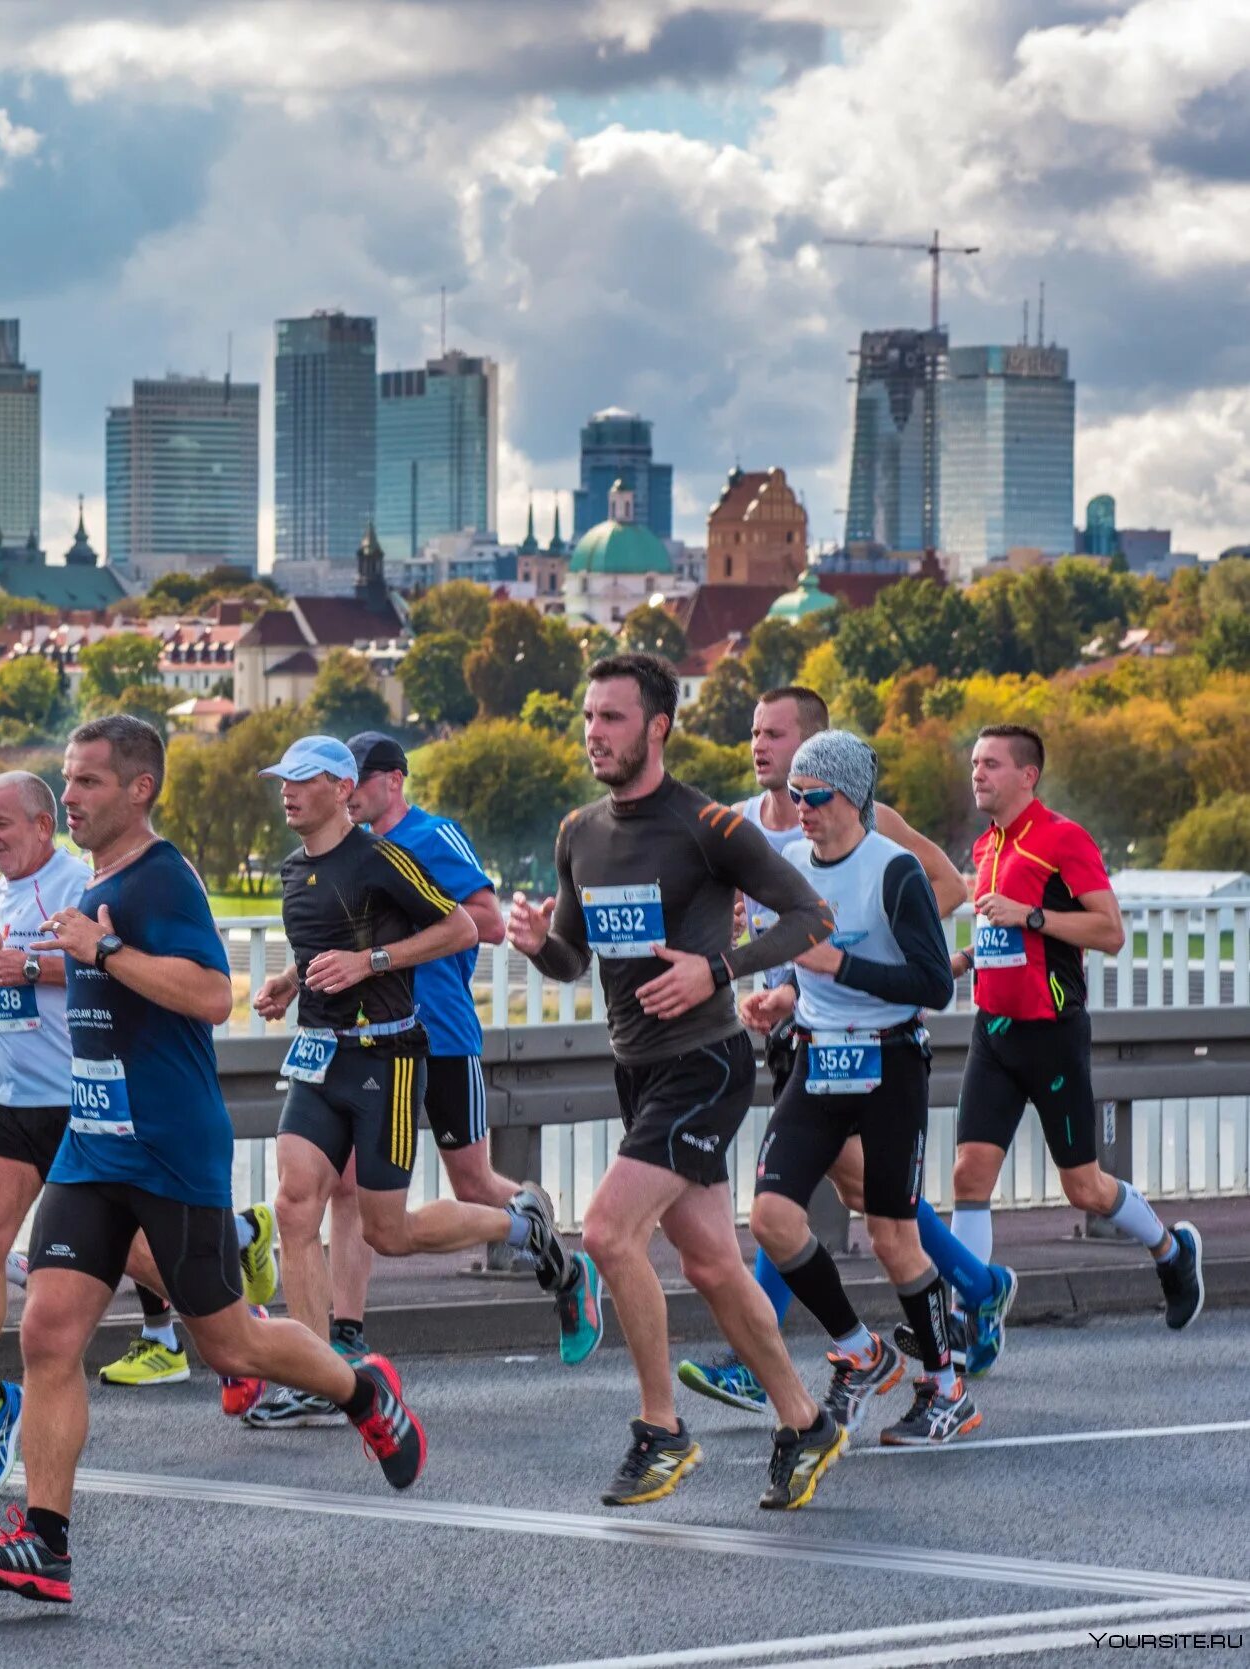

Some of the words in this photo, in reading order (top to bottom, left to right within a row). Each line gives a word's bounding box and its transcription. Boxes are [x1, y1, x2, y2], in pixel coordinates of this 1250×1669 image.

[596, 907, 646, 933] 3532
[978, 928, 1009, 948] 4942
[818, 1048, 865, 1072] 3567
